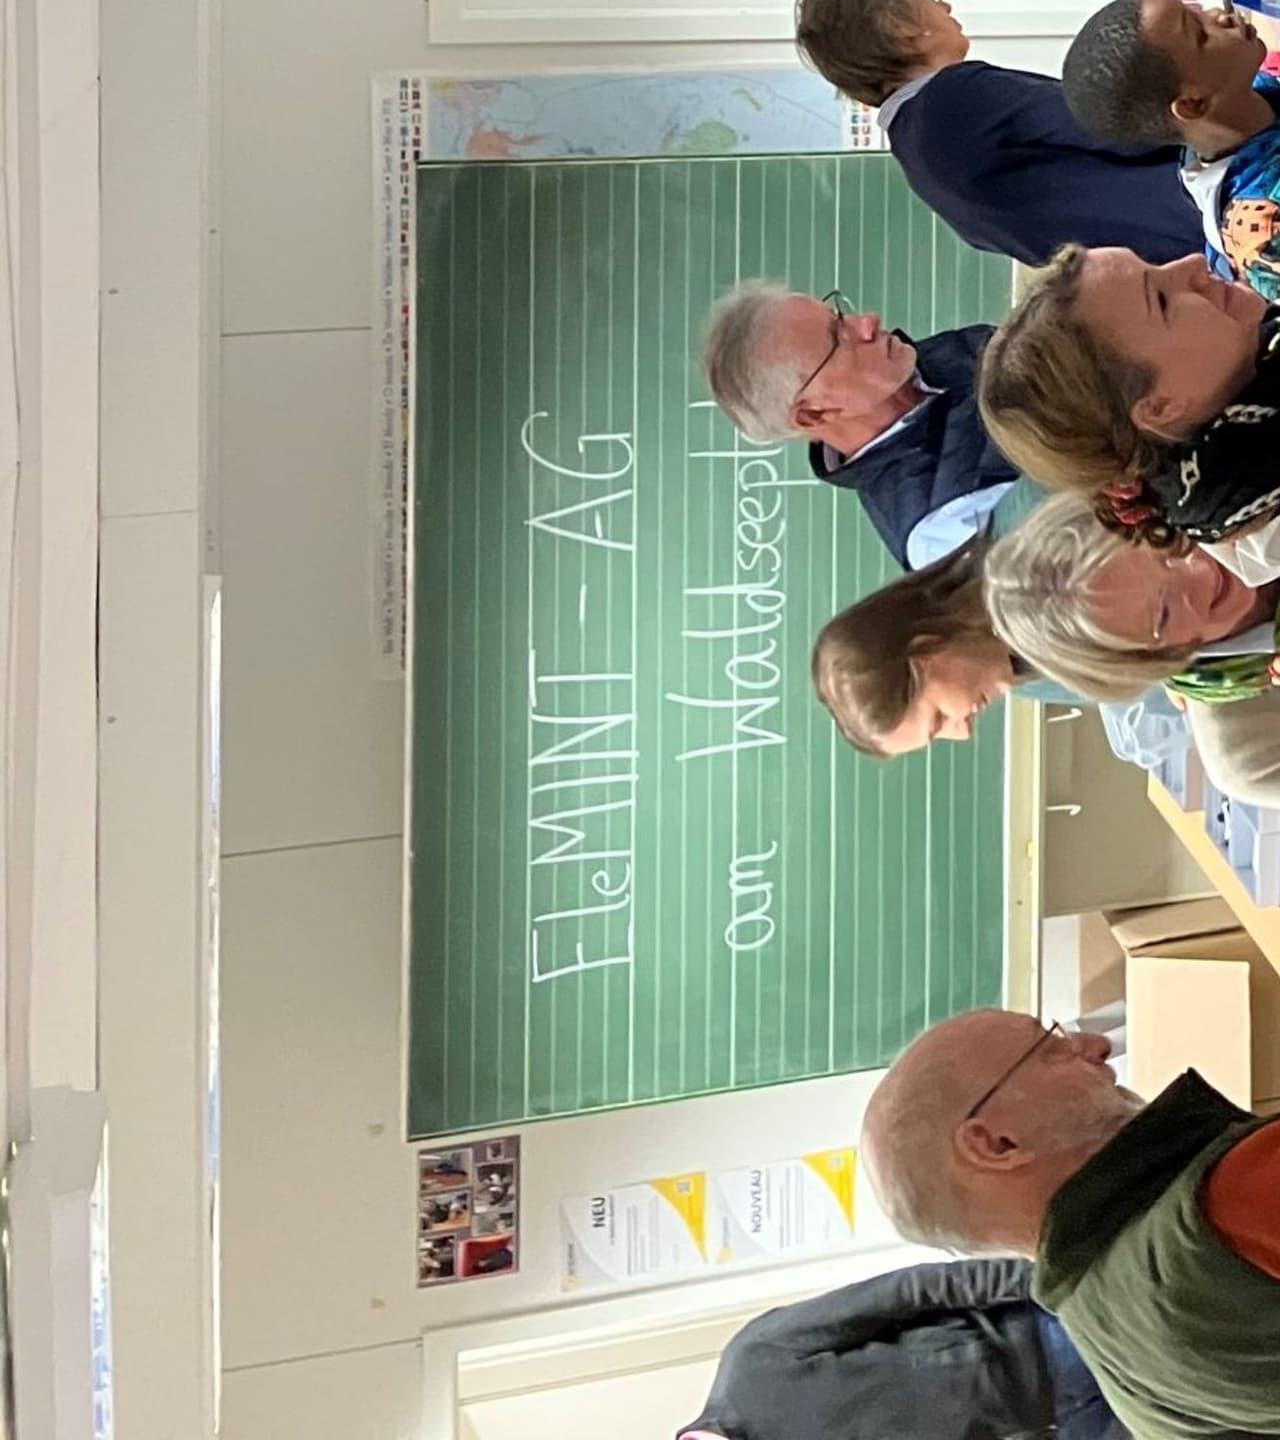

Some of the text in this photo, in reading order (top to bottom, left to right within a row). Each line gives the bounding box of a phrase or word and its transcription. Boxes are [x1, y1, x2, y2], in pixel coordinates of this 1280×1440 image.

[665, 399, 820, 952] am Waldseepl
[591, 1196, 606, 1228] NEU
[750, 1169, 762, 1234] NOUVEAU
